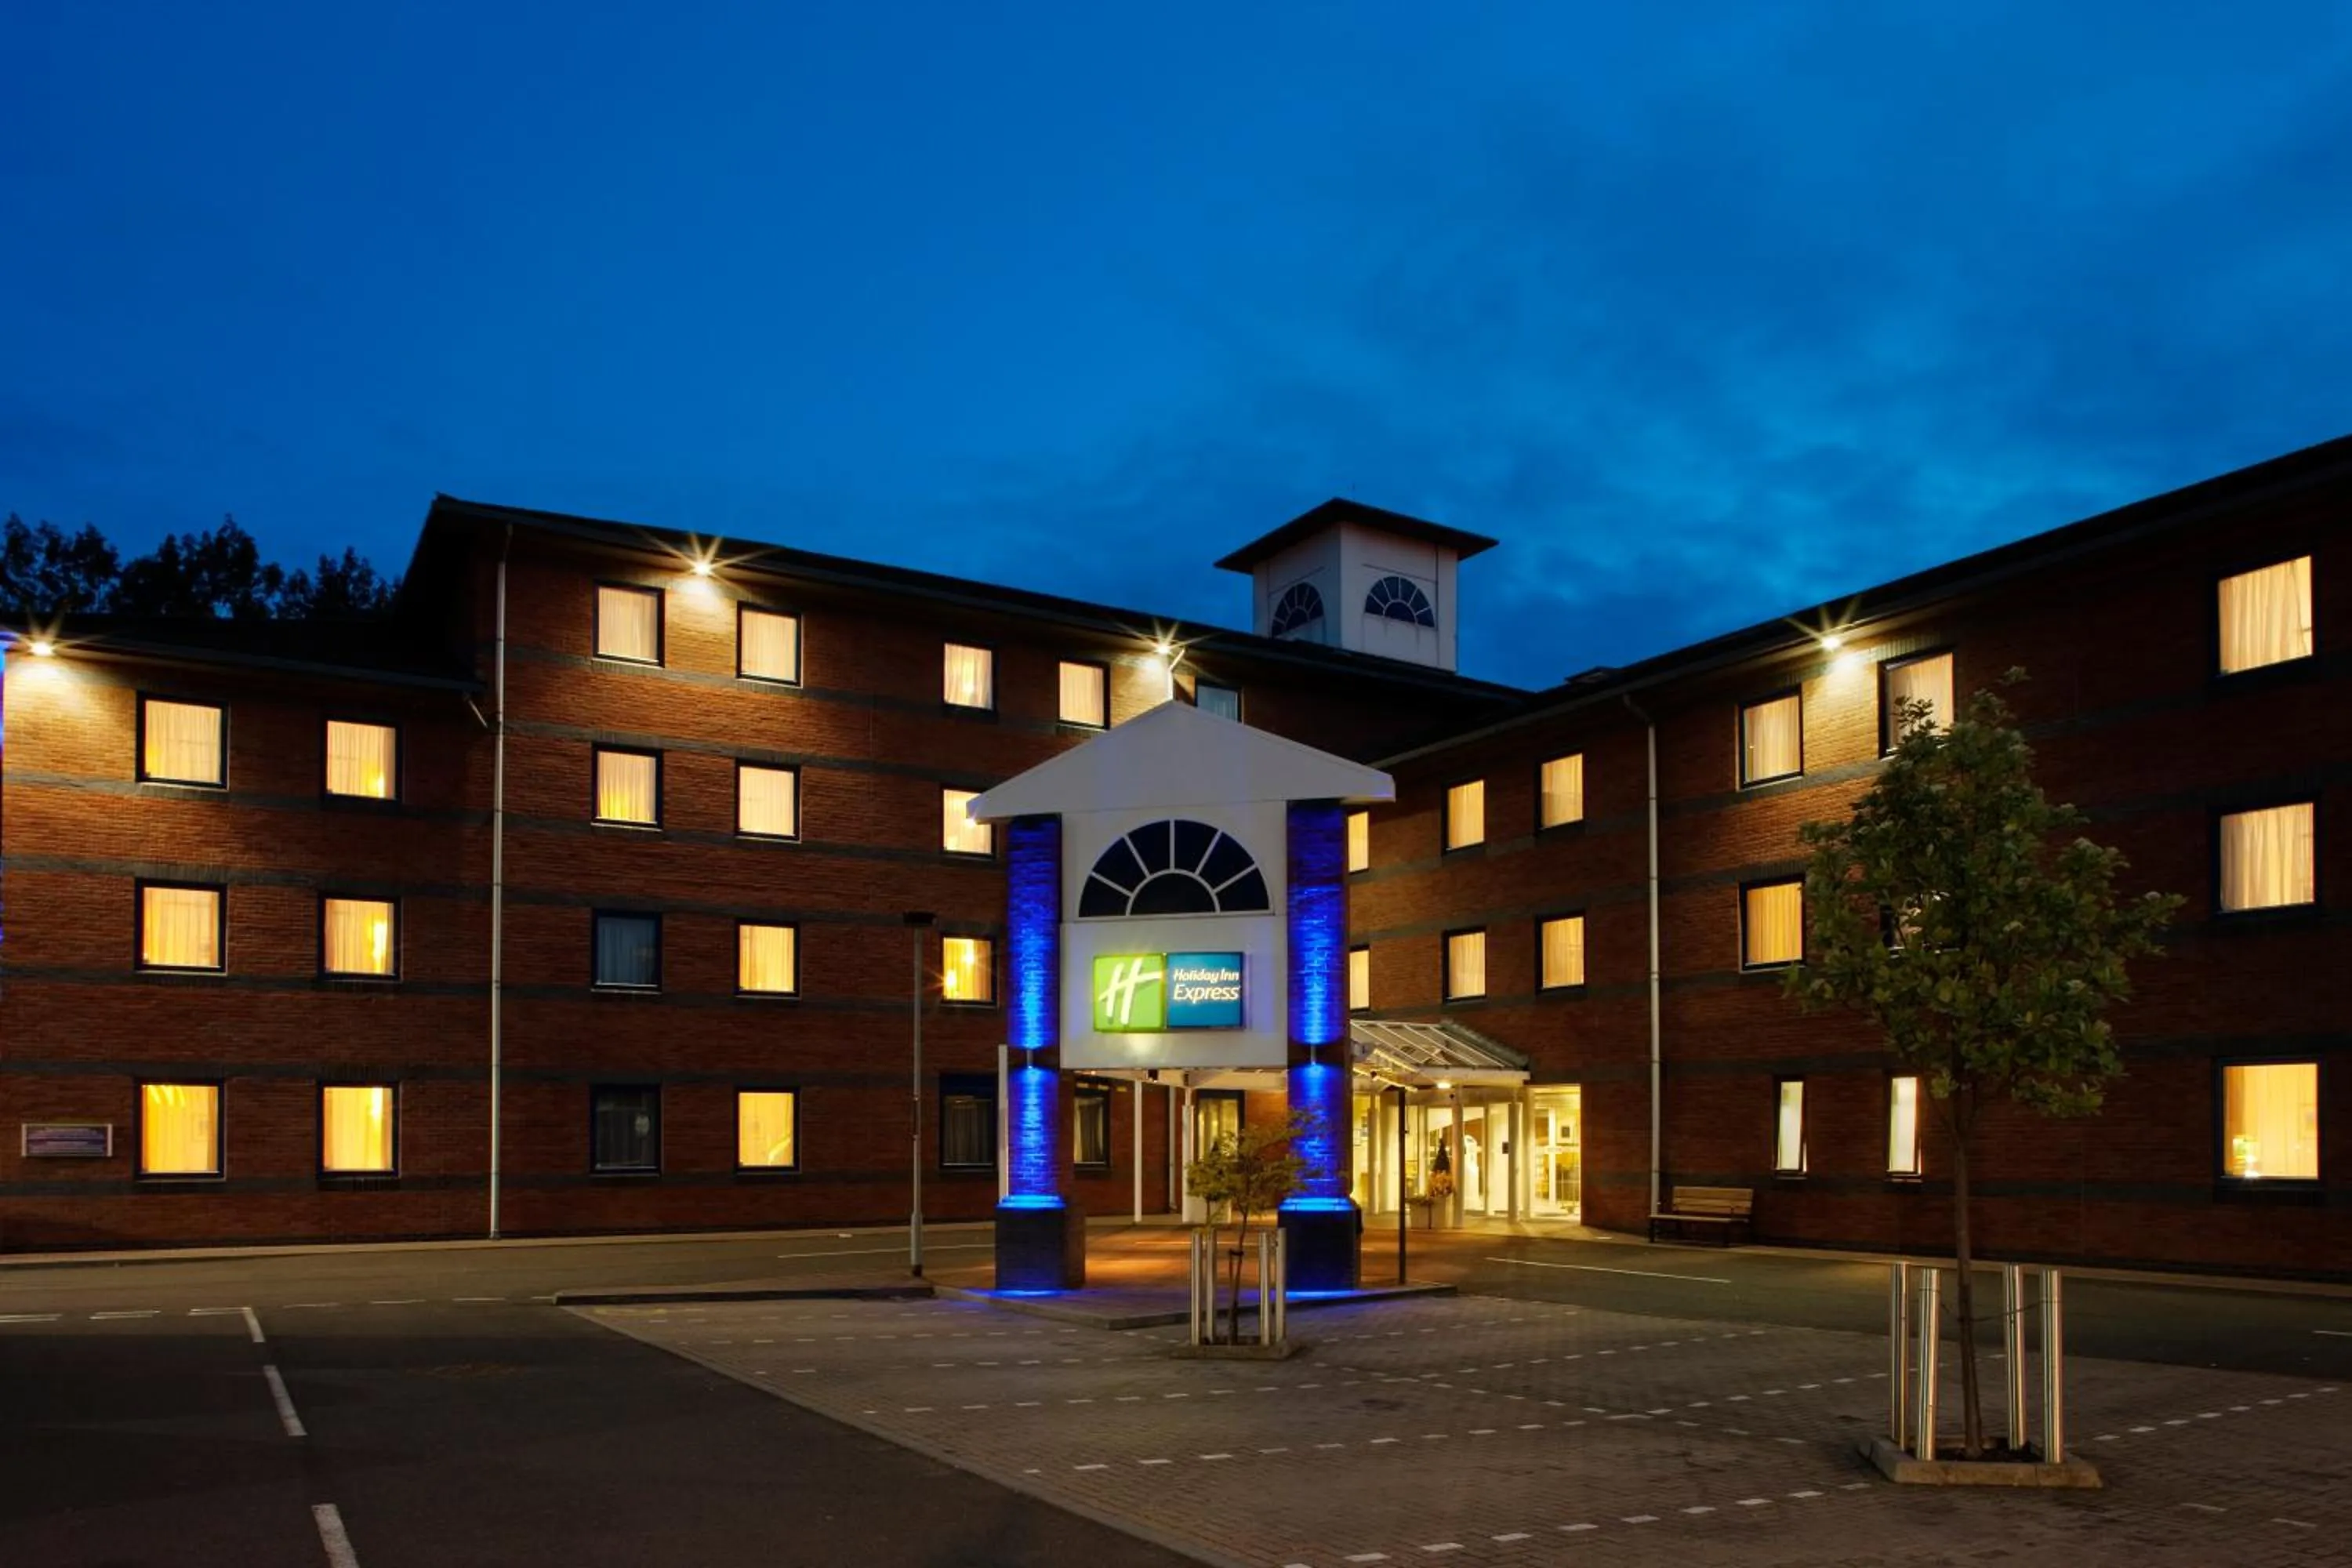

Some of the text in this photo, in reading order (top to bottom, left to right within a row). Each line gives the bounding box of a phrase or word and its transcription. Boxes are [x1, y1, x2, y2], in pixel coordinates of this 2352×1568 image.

[1174, 967, 1240, 983] Holiday Inn
[1174, 983, 1240, 1004] Express
